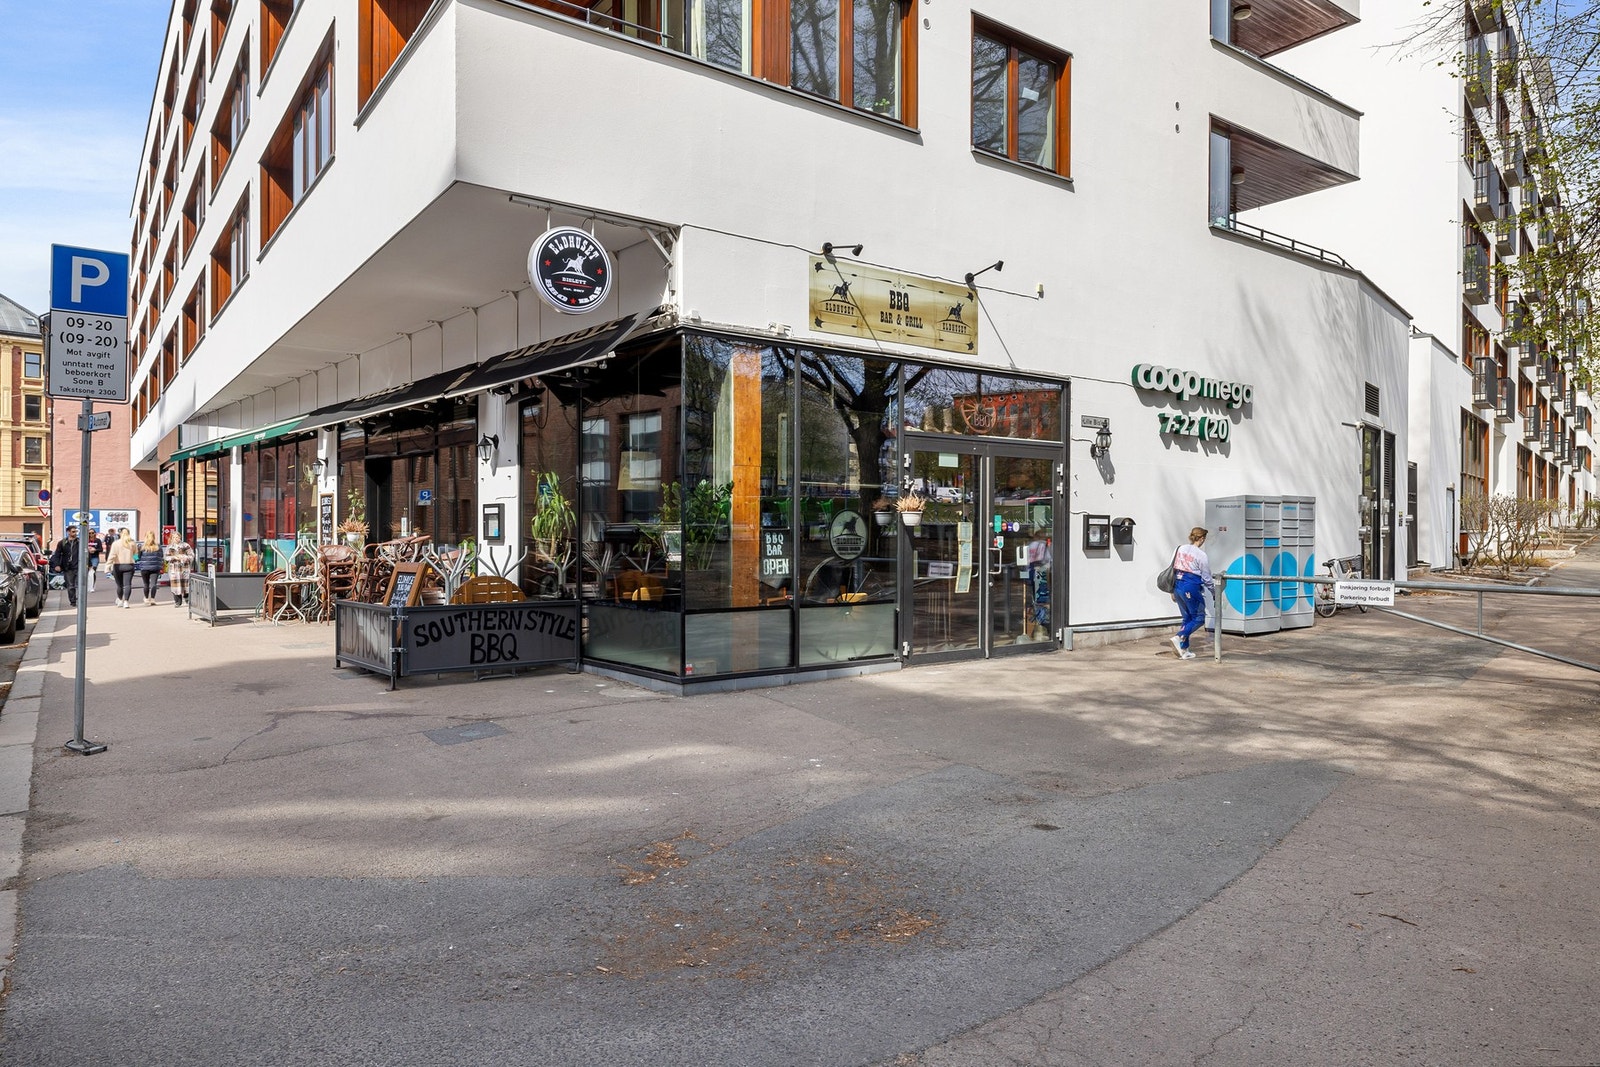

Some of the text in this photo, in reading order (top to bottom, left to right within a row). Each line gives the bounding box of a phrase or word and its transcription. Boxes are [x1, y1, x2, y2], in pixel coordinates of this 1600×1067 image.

[547, 235, 600, 260] ELDHUSET
[71, 256, 110, 304] P
[578, 286, 603, 304] BAR
[889, 290, 910, 312] BBQ
[825, 302, 855, 315] ELDHUSET
[880, 311, 924, 329] BAR & GRILL
[942, 322, 967, 333] ELDHUSET
[87, 351, 111, 359] avgift
[65, 369, 111, 378] beboerkort
[73, 378, 93, 386] Sone
[59, 386, 95, 394] Takstsone
[1133, 363, 1253, 409] coop mega
[1159, 412, 1231, 443] 7-22 (20)
[764, 532, 784, 545] BBQ
[766, 544, 783, 556] BAR
[763, 558, 790, 575] OPEN
[1339, 584, 1368, 592] Innkjøring
[413, 609, 576, 648] SOUTHERN STYLE
[470, 632, 520, 665] BBQ
